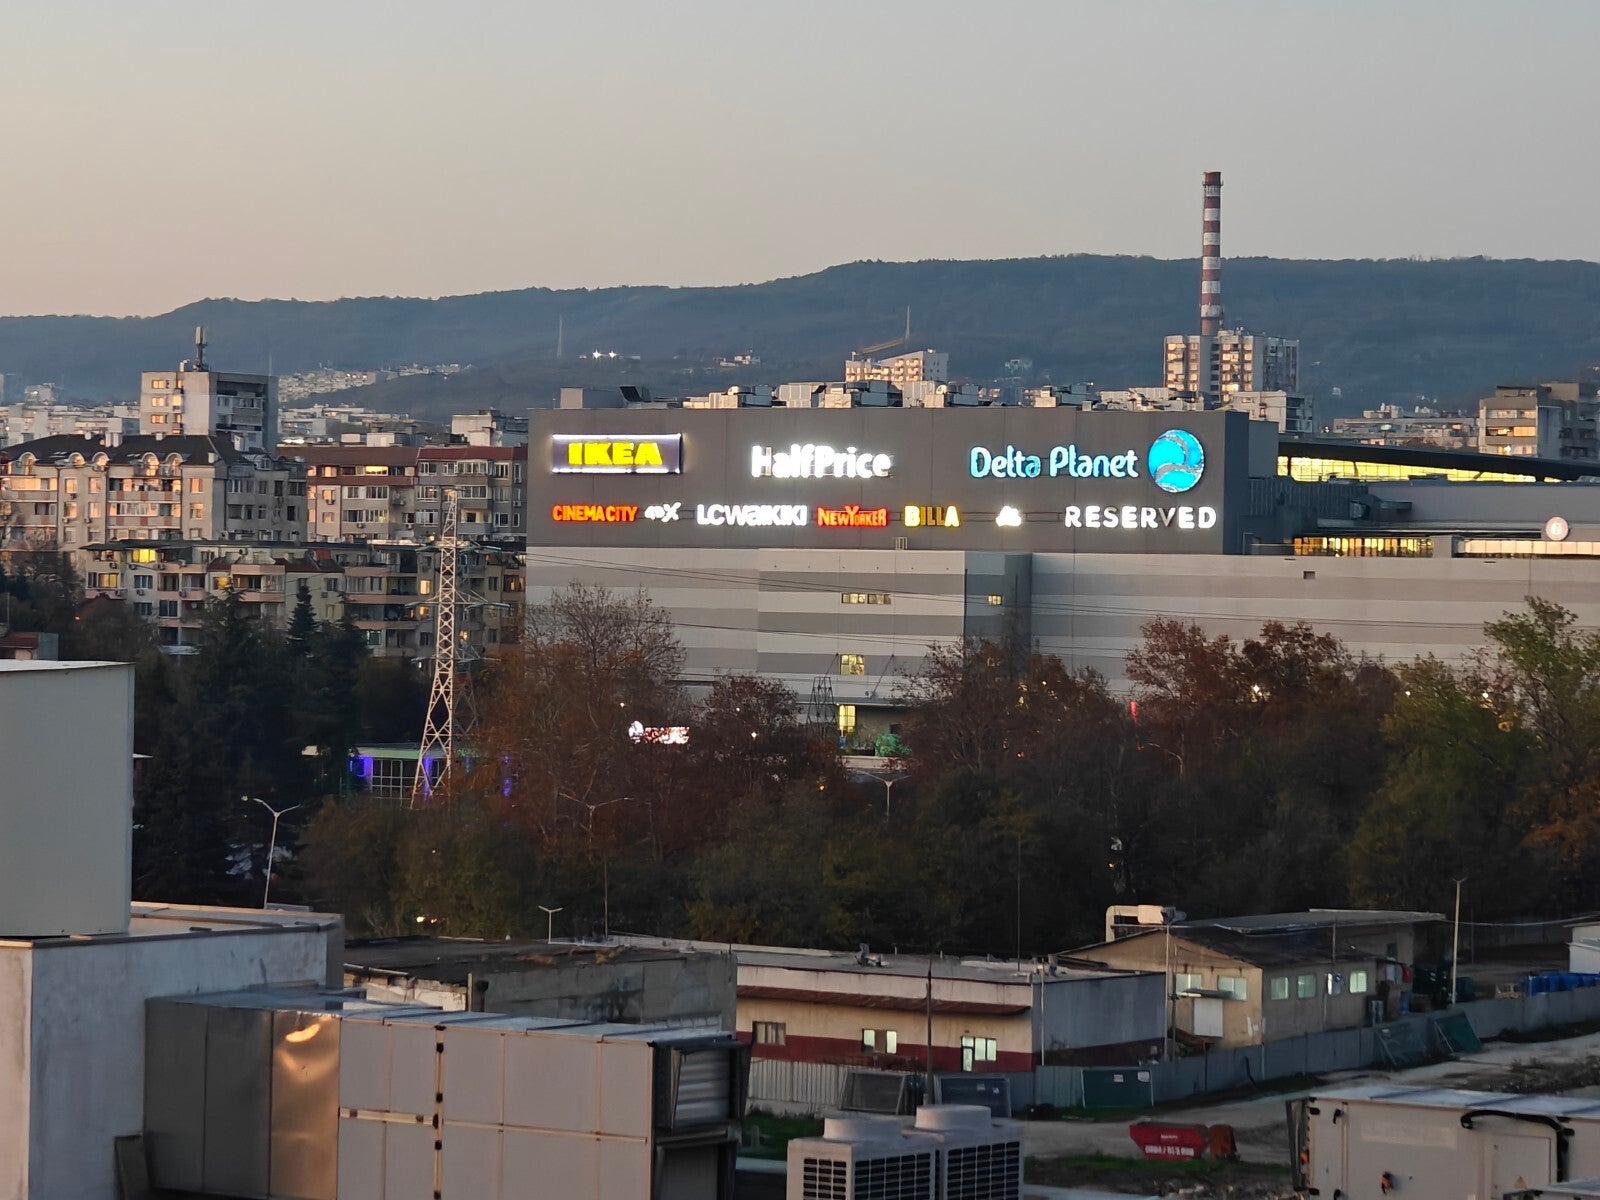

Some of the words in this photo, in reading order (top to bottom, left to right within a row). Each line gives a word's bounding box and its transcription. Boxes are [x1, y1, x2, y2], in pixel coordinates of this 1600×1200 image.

[568, 441, 663, 465] IKEA
[751, 443, 891, 478] HalfPrice
[970, 445, 1041, 477] Delta
[1050, 444, 1139, 477] Planet
[904, 505, 960, 527] BILLA
[1064, 505, 1217, 529] RESERVED
